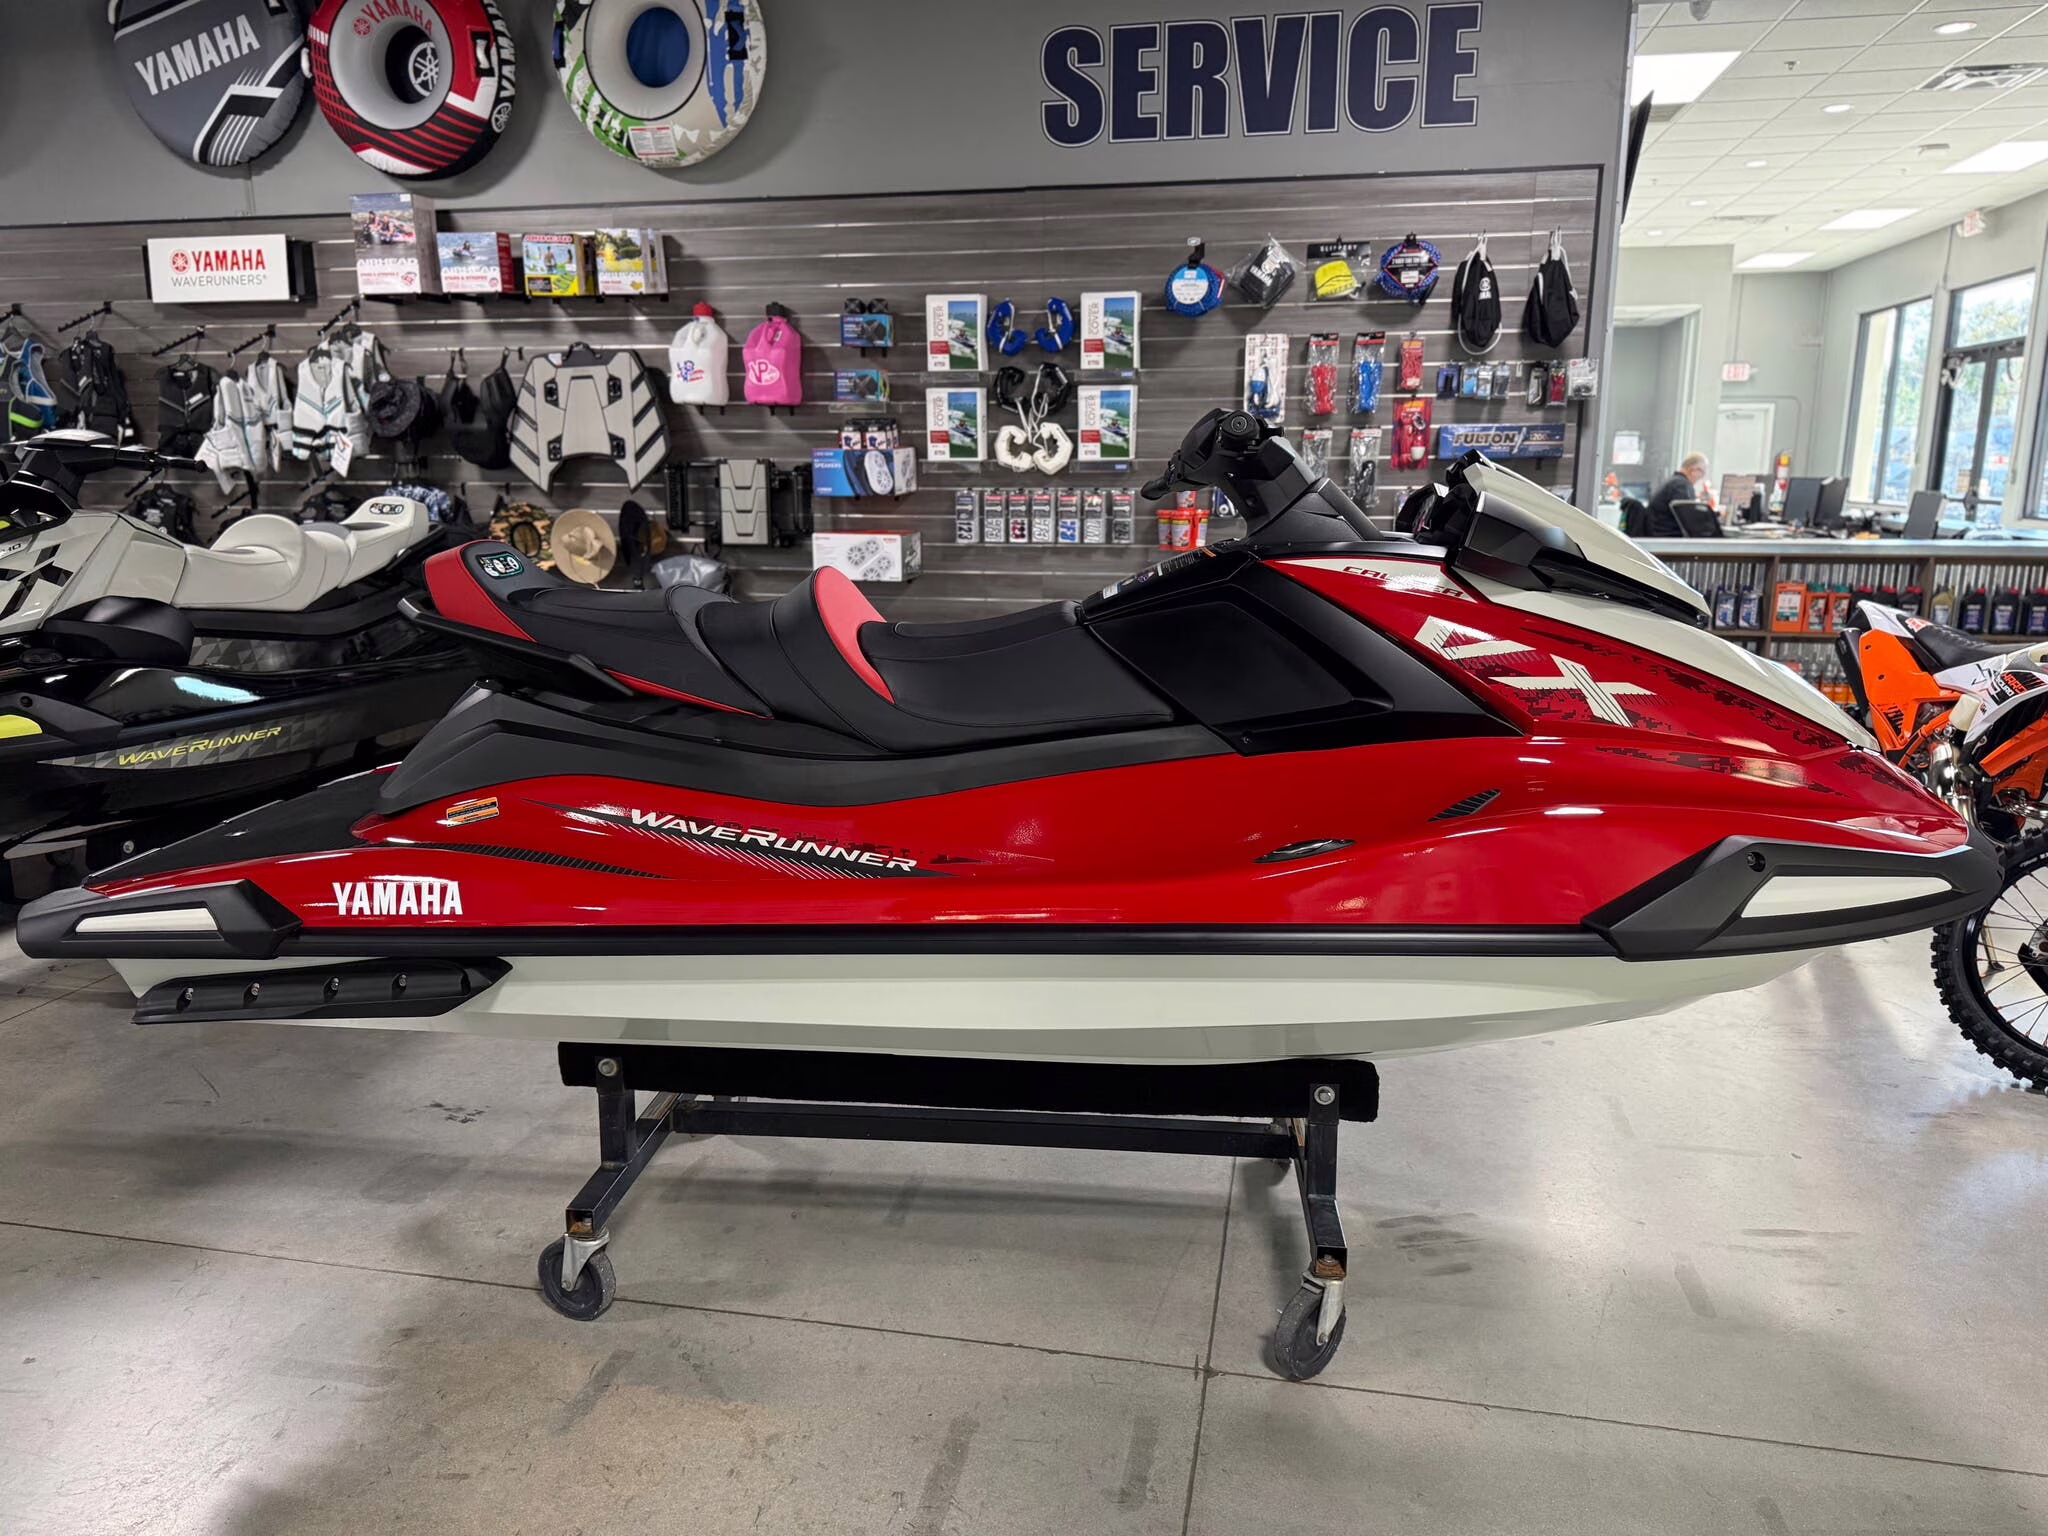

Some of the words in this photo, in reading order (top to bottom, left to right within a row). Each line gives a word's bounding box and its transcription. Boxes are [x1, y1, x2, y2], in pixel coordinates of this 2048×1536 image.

[361, 0, 432, 36] YAMAHA
[134, 14, 261, 96] YAMAHA
[1041, 2, 1482, 148] SERVICE
[191, 249, 266, 272] YAMAHA
[935, 305, 945, 338] COVER
[935, 396, 945, 428] COVER
[1086, 394, 1096, 427] COVER
[1453, 431, 1519, 446] FULTON
[2002, 673, 2029, 695] HARD
[332, 881, 463, 916] YAMAHA
